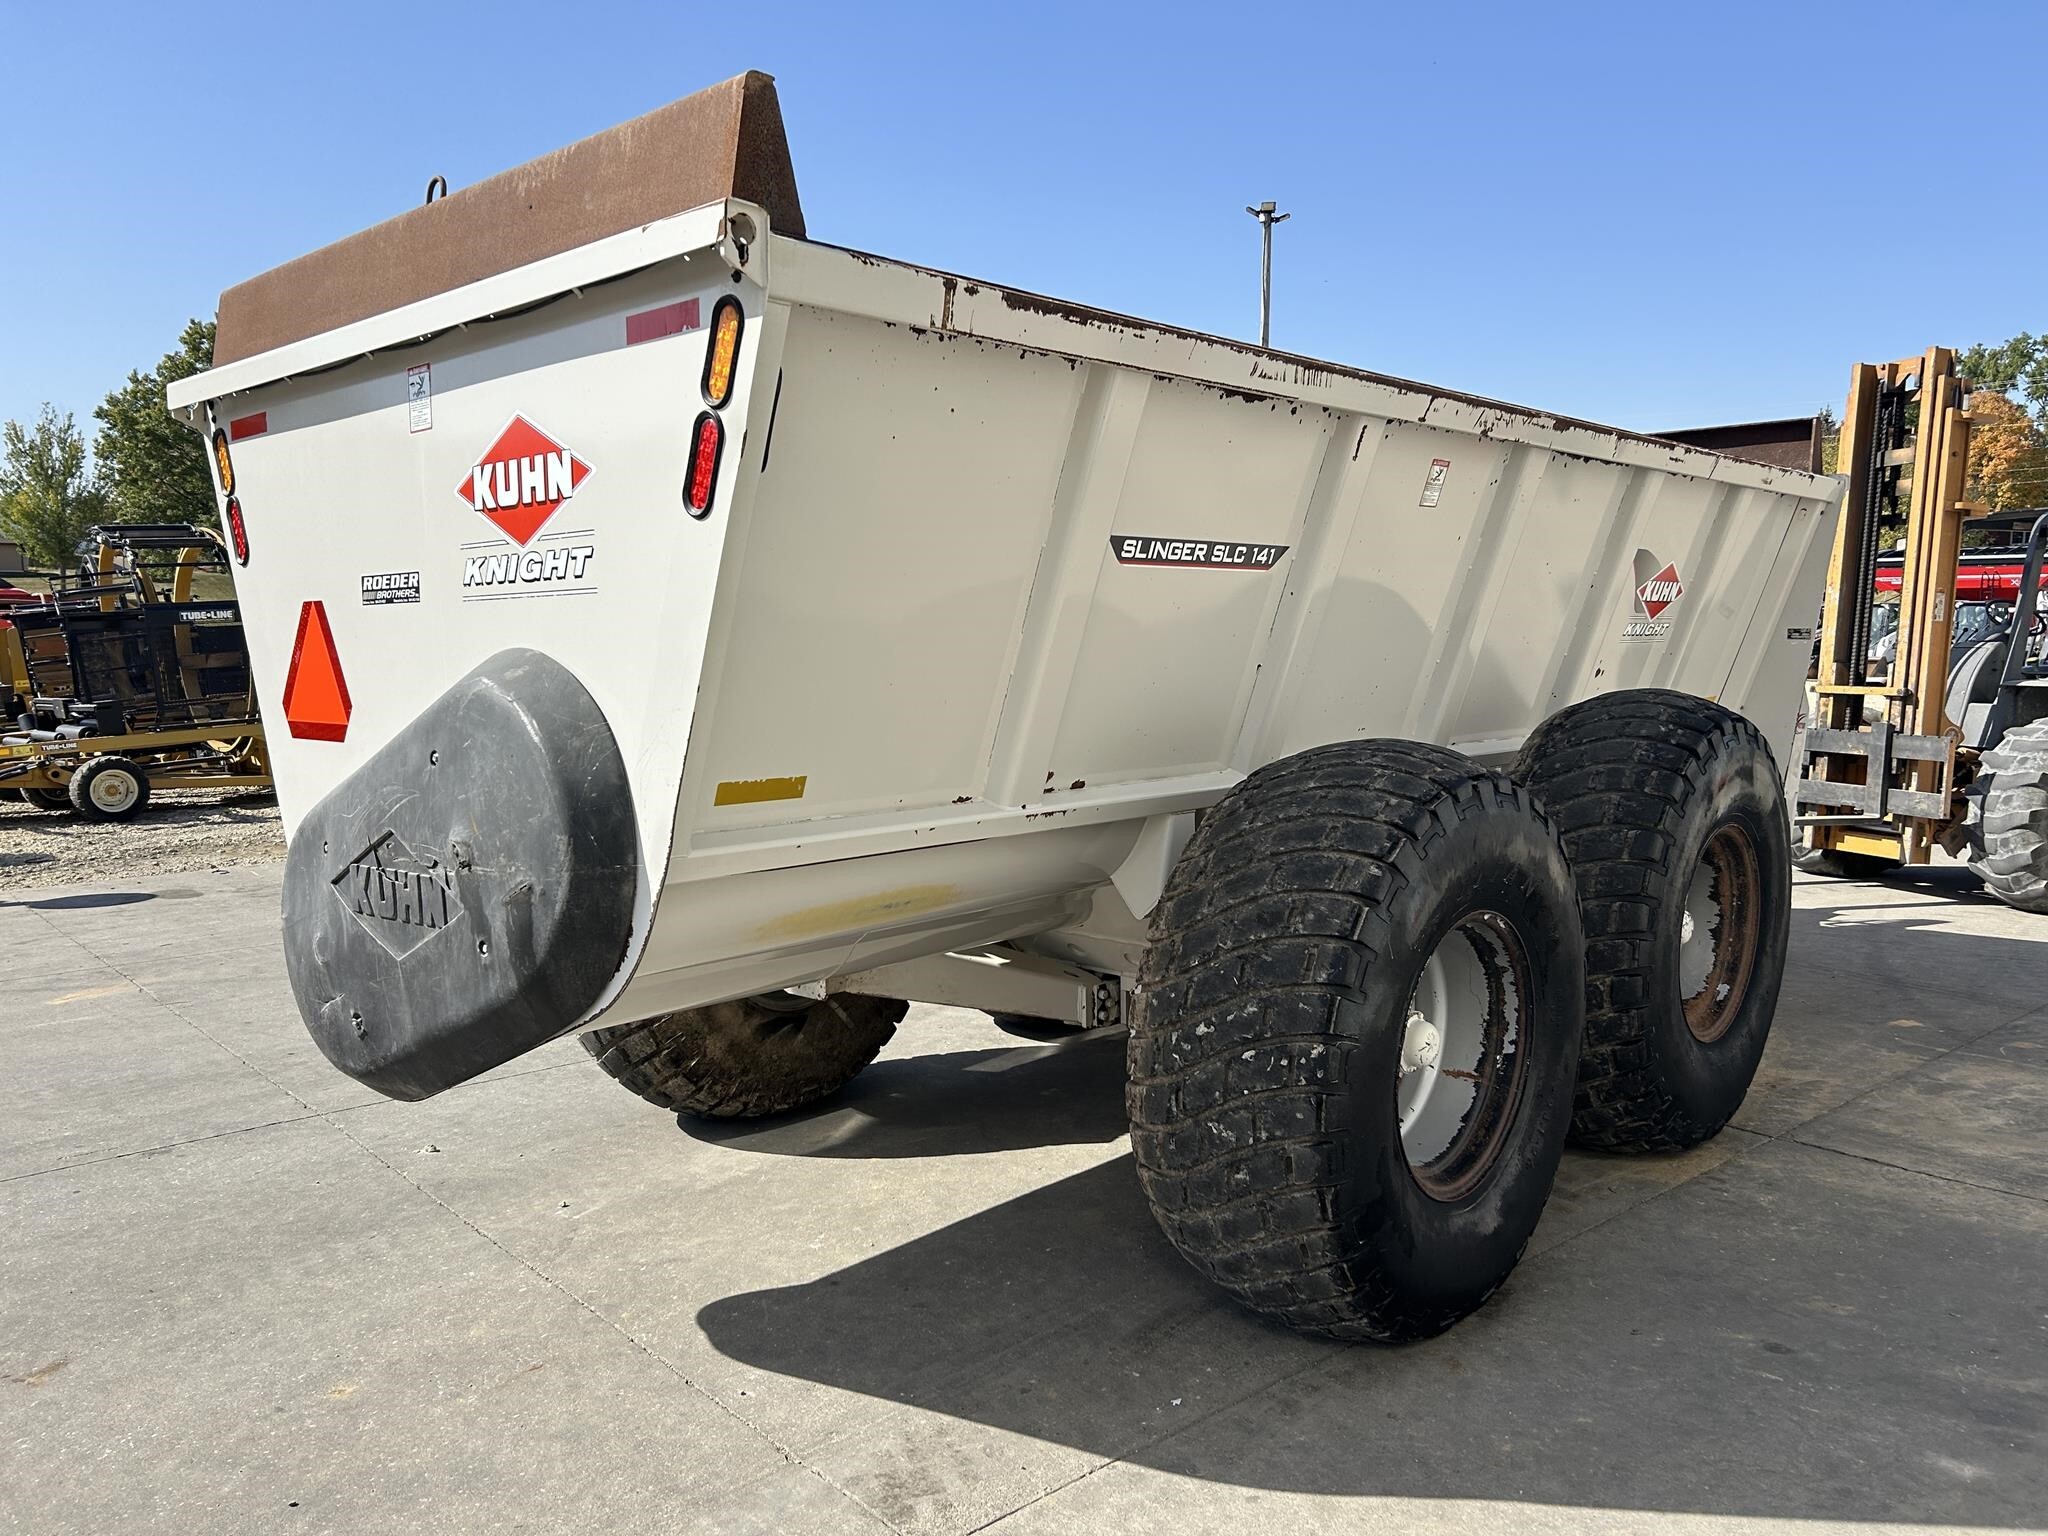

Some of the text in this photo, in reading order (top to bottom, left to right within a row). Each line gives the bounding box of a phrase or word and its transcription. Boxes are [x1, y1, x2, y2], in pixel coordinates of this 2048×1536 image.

[472, 449, 574, 512] KUHN
[1121, 539, 1276, 565] SLINGER SLC 141
[463, 546, 594, 587] KNIGHT
[362, 573, 419, 591] ROEDER
[1642, 580, 1681, 603] KUHN
[376, 589, 416, 600] BROTHERS
[1622, 623, 1670, 637] KNIGHT
[350, 863, 456, 930] KUHN
